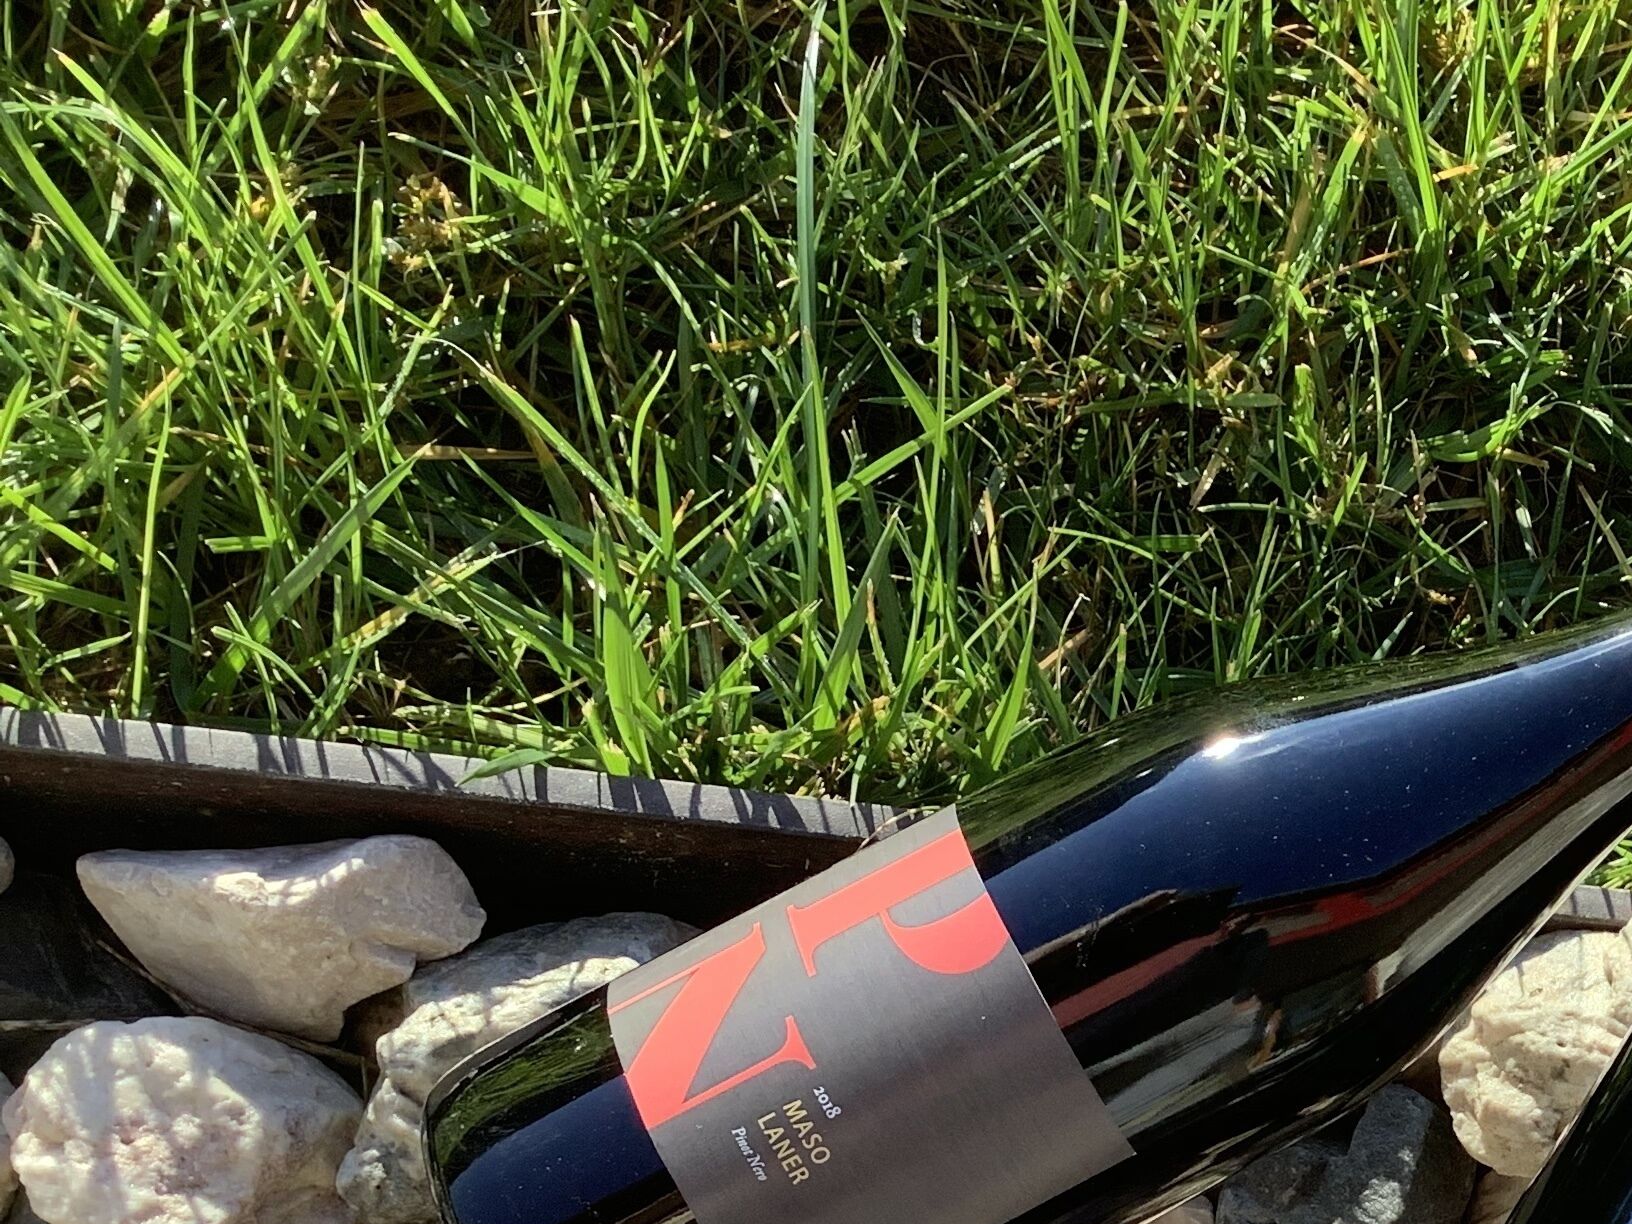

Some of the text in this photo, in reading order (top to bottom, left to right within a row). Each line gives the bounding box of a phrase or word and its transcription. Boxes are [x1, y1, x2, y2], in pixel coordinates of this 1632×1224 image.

[812, 1086, 842, 1119] 2018
[731, 1126, 754, 1156] Pinot
[757, 1111, 810, 1185] LANER
[782, 1099, 831, 1164] MASO
